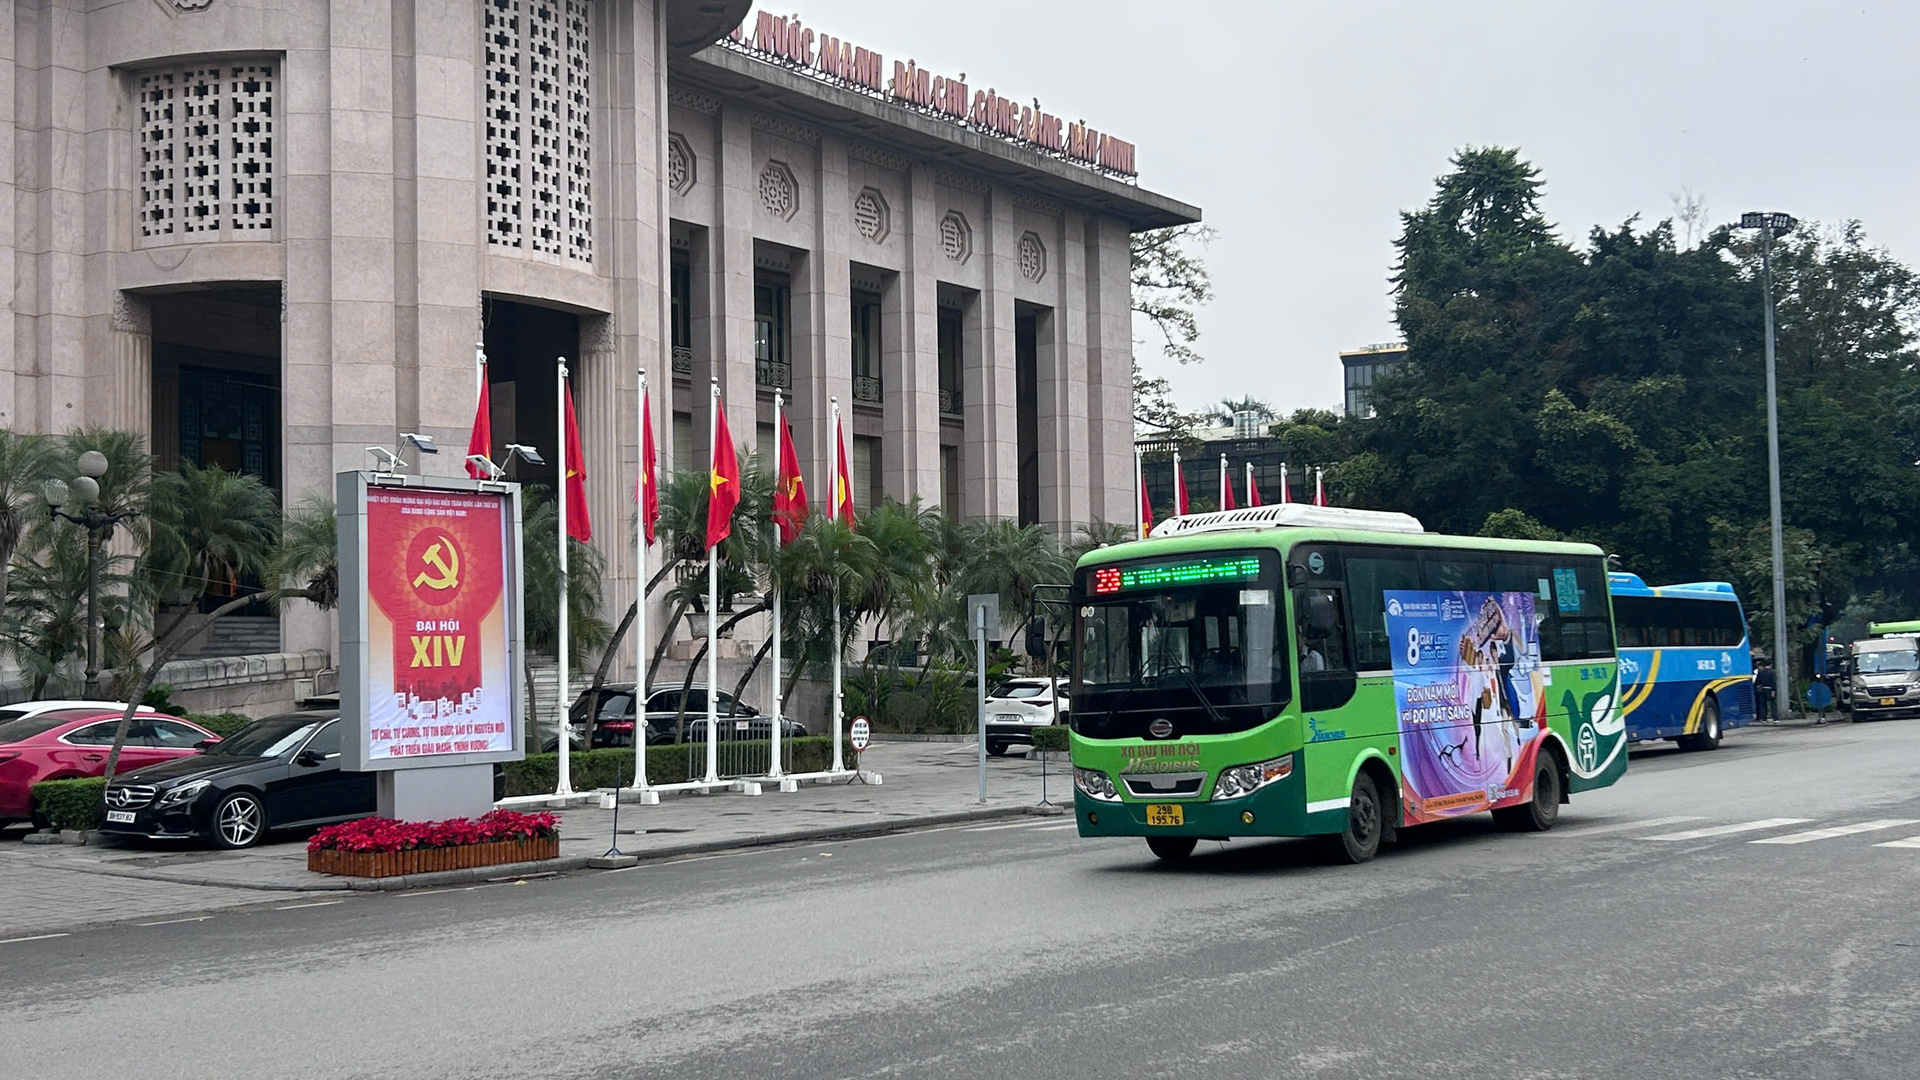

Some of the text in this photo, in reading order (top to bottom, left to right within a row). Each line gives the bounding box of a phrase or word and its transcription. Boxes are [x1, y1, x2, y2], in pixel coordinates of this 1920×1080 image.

[757, 9, 814, 67] NƯỚC
[416, 618, 460, 633] ĐẠI HỘI
[410, 635, 467, 668] XIV
[1407, 626, 1420, 666] 8
[1407, 684, 1424, 703] ĐÓN
[1424, 681, 1442, 701] NĂM
[1412, 704, 1430, 724] ĐÔI
[1430, 700, 1448, 722] MẮT
[1138, 744, 1157, 757] BUS
[1160, 742, 1176, 756] HÀ
[1178, 740, 1201, 757] NỘI
[1151, 815, 1180, 825] 195.76
[1156, 805, 1174, 815] 29B
